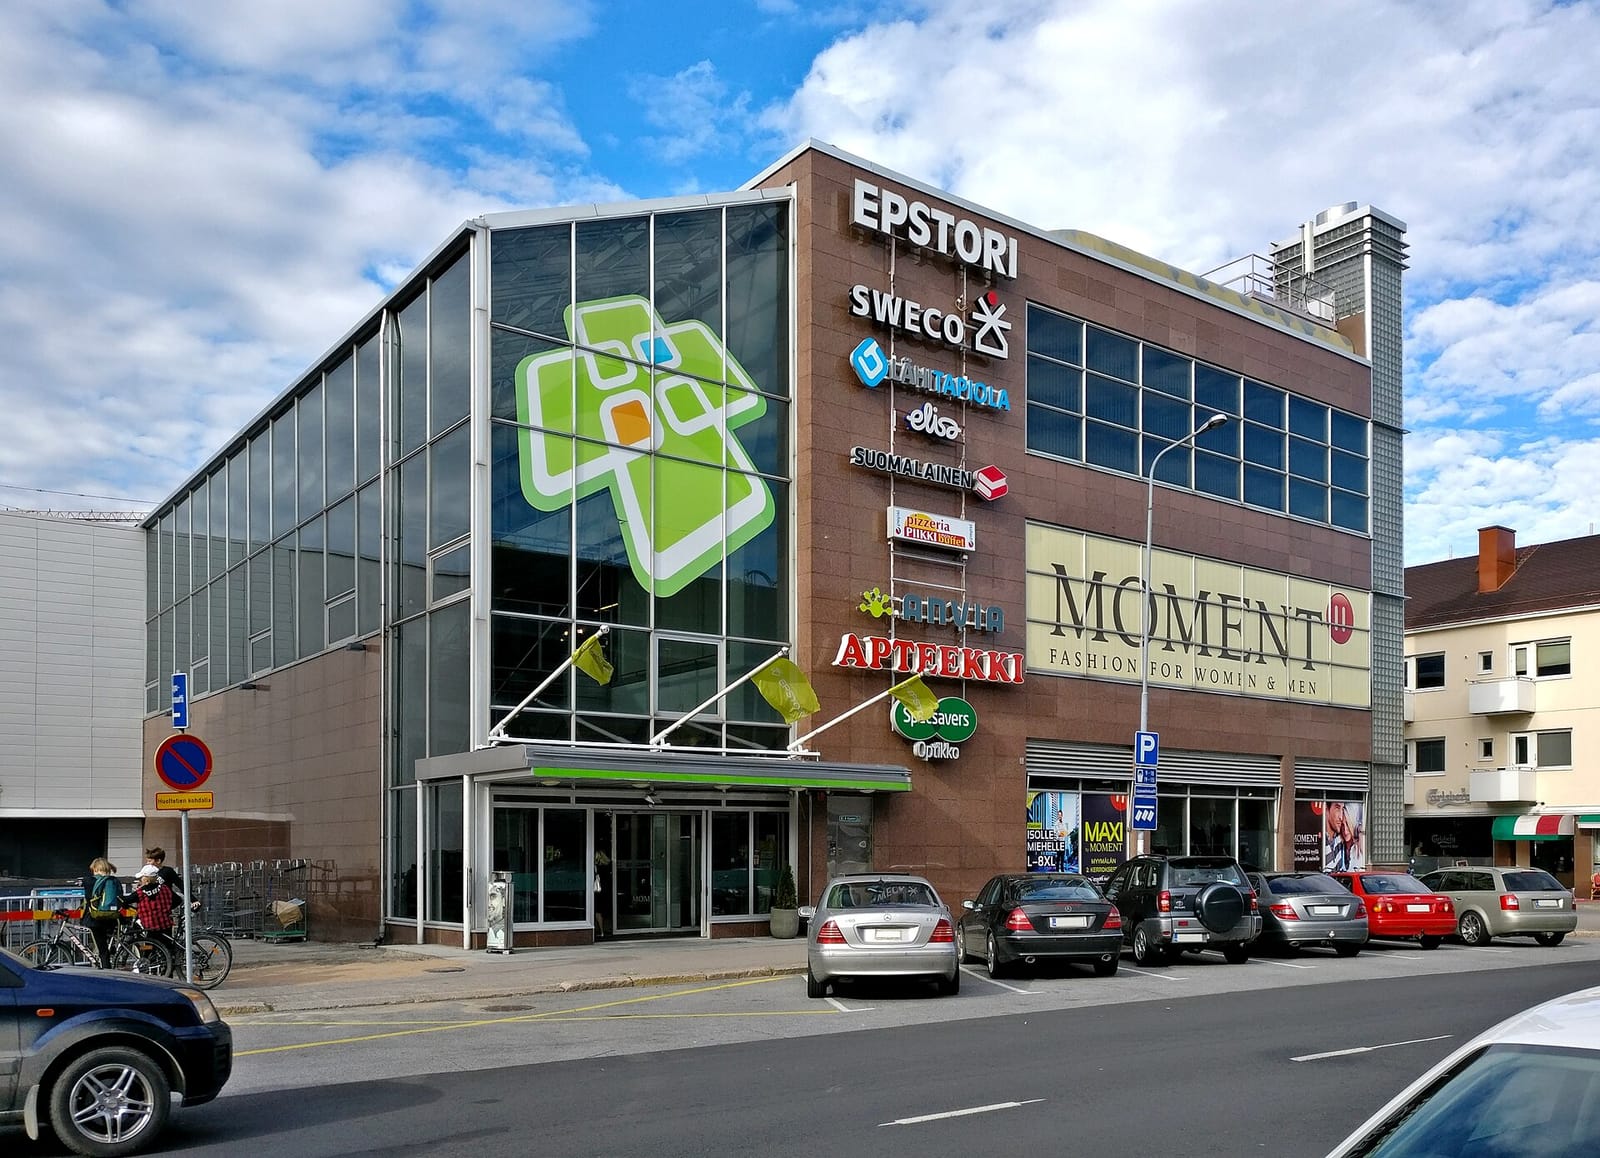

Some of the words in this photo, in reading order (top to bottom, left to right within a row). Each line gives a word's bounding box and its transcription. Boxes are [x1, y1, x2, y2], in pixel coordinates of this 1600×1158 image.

[852, 178, 1018, 279] EPSTORI
[851, 284, 964, 344] SWECO
[886, 356, 1011, 411] LÄHITAPIOLA
[907, 402, 961, 440] elisa
[853, 447, 972, 488] SUOMALAINEN
[906, 514, 950, 532] pizzeria
[906, 528, 937, 541] PIIKKI
[1050, 563, 1323, 671] MOMENT
[834, 633, 1024, 684] APTEEKKI
[1050, 648, 1137, 673] FASHION
[1151, 661, 1183, 680] FOR
[1194, 666, 1257, 688] WOMEN
[1267, 676, 1275, 690] &
[1288, 680, 1317, 695] MEN
[903, 708, 970, 727] Spsavers
[914, 740, 960, 761] Optikko
[1140, 734, 1156, 762] P
[1027, 830, 1054, 840] ISOLLE
[1084, 821, 1124, 842] MAXI
[1027, 841, 1065, 851] MIEHELLE
[1090, 843, 1123, 852] MOMENT
